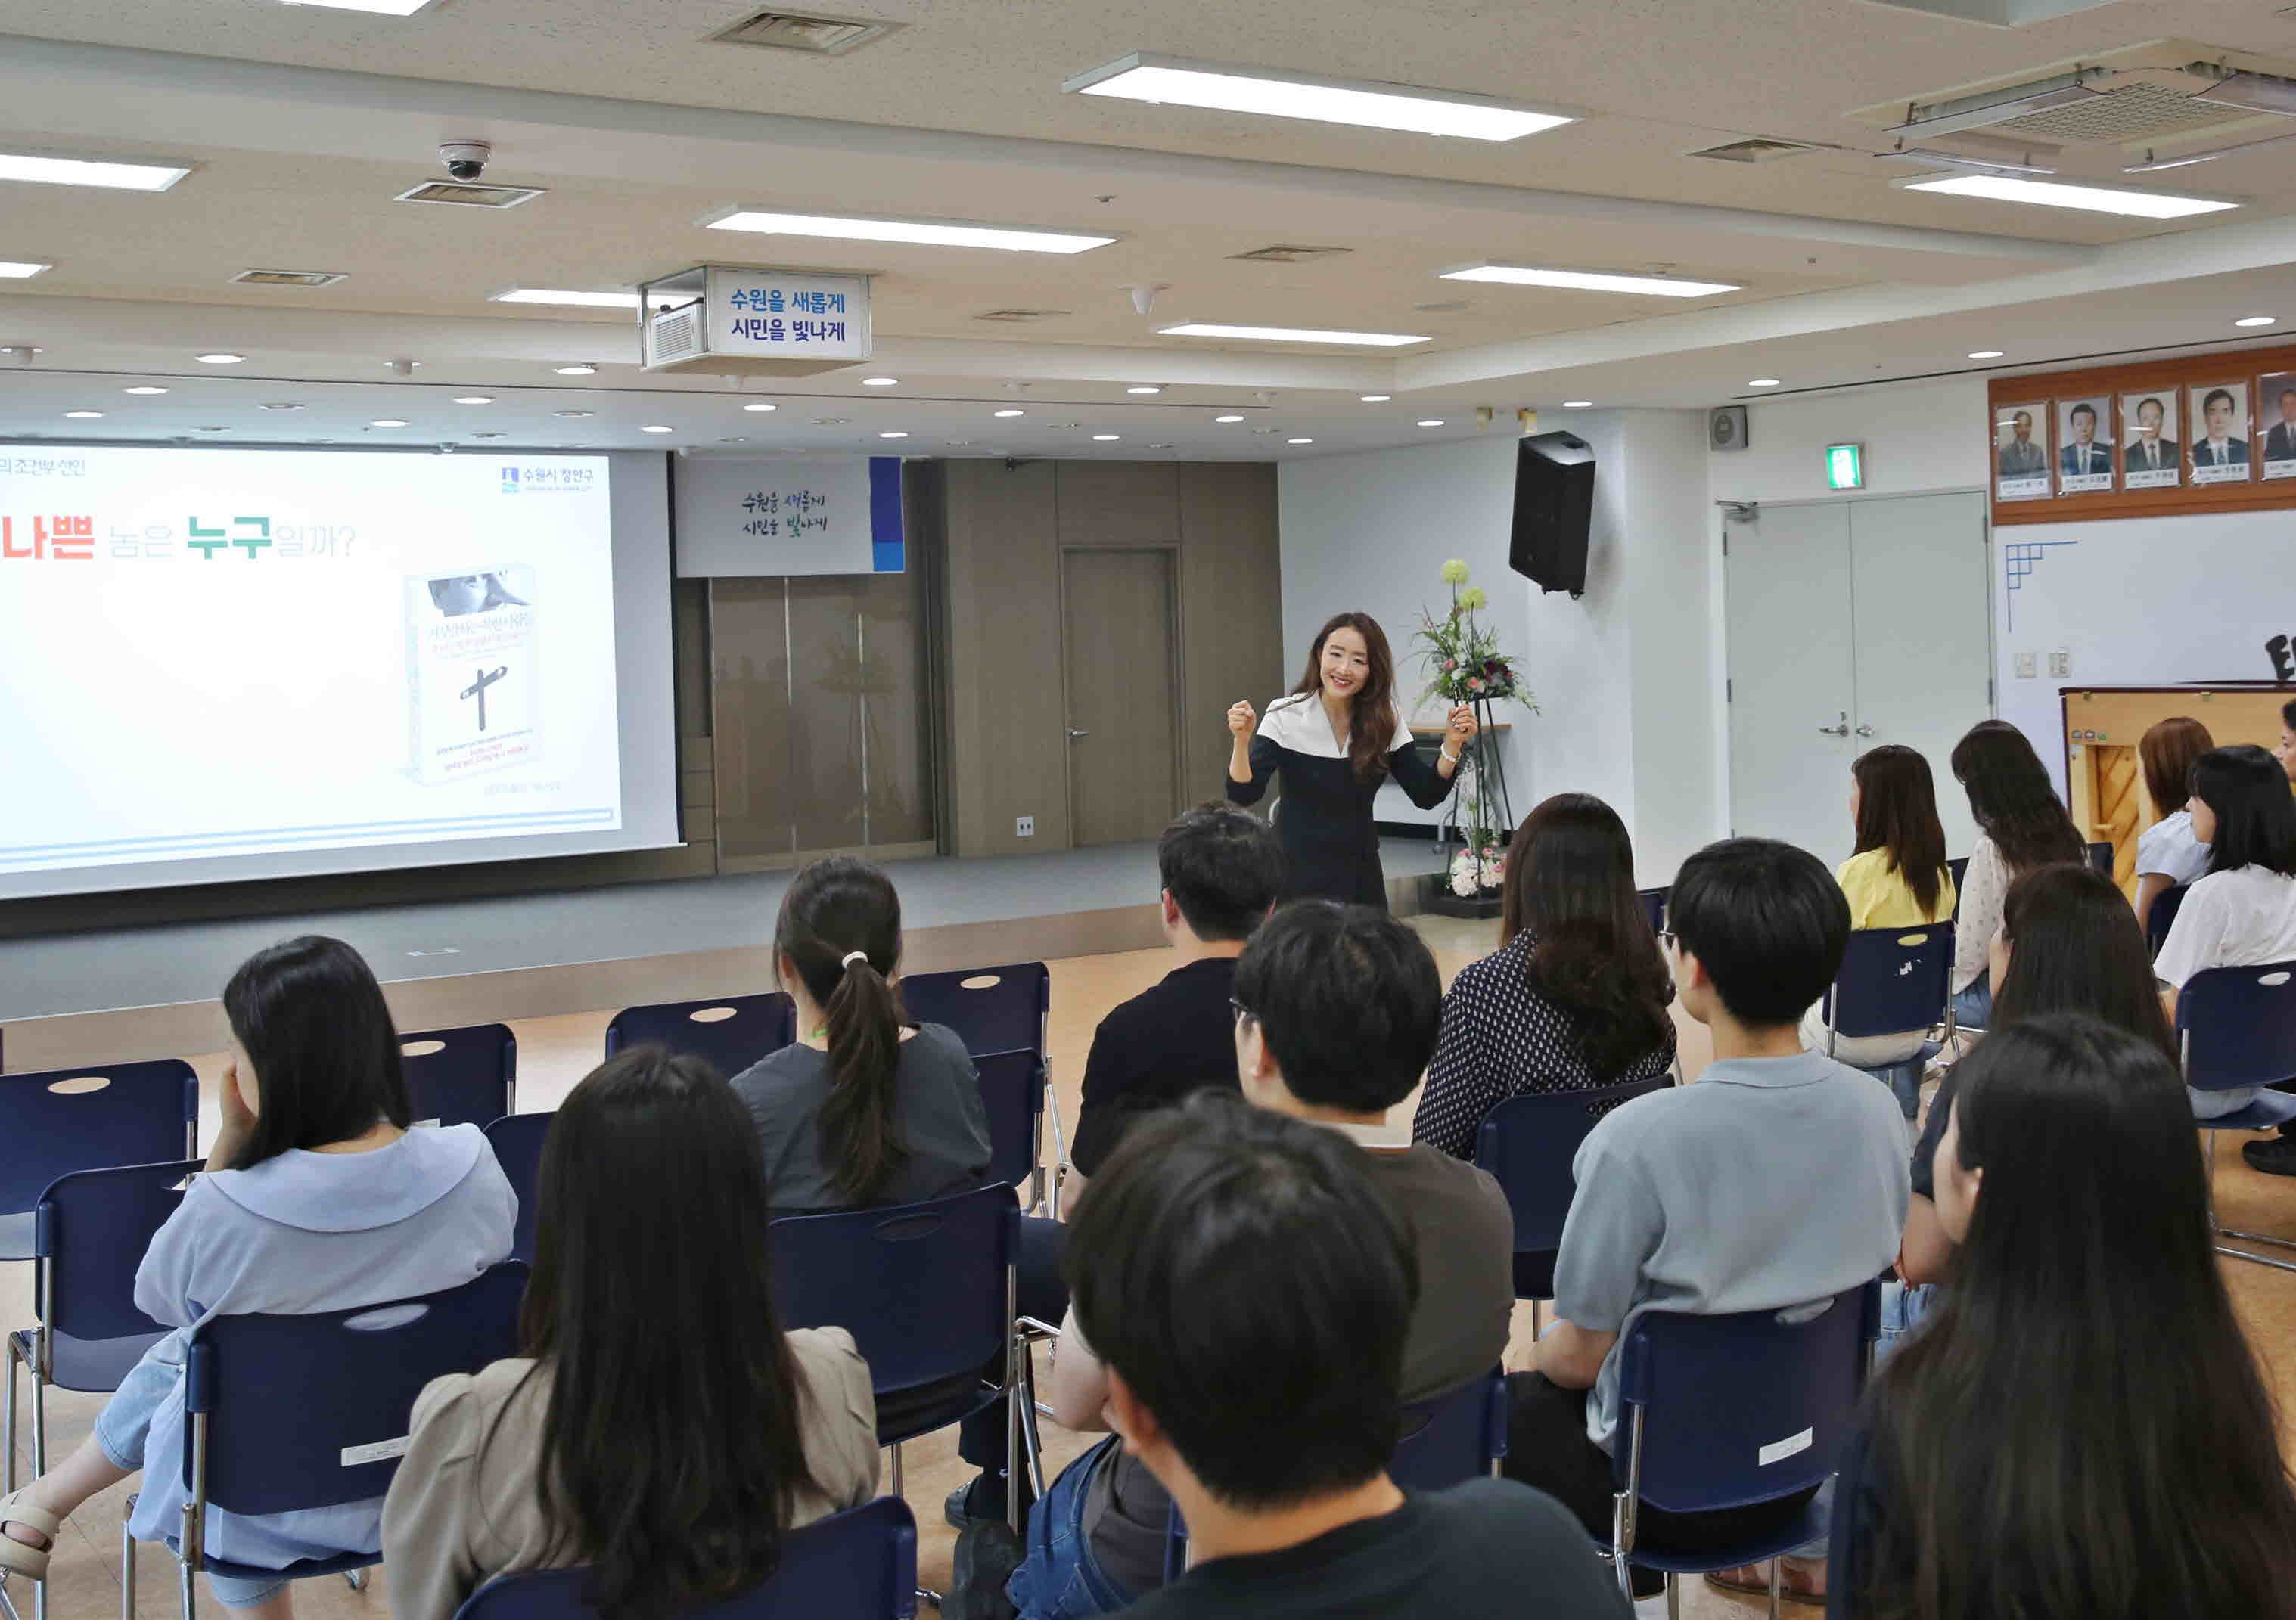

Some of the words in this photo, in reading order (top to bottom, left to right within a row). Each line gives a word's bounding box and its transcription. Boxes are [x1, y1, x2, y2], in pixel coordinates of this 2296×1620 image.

[730, 288, 785, 312] 수원을
[791, 291, 845, 314] 새롭게
[732, 318, 786, 341] 시민을
[792, 320, 845, 341] 빛나게
[524, 467, 557, 483] 수원시
[561, 467, 594, 484] 장안구
[742, 492, 778, 513] 수원을
[783, 490, 825, 513] 새롭게
[743, 518, 778, 535] 시민을
[786, 514, 828, 538] 빛나게
[2, 516, 95, 559] 나쁜
[109, 526, 174, 558] 놈은
[187, 516, 357, 560] 누구일까?
